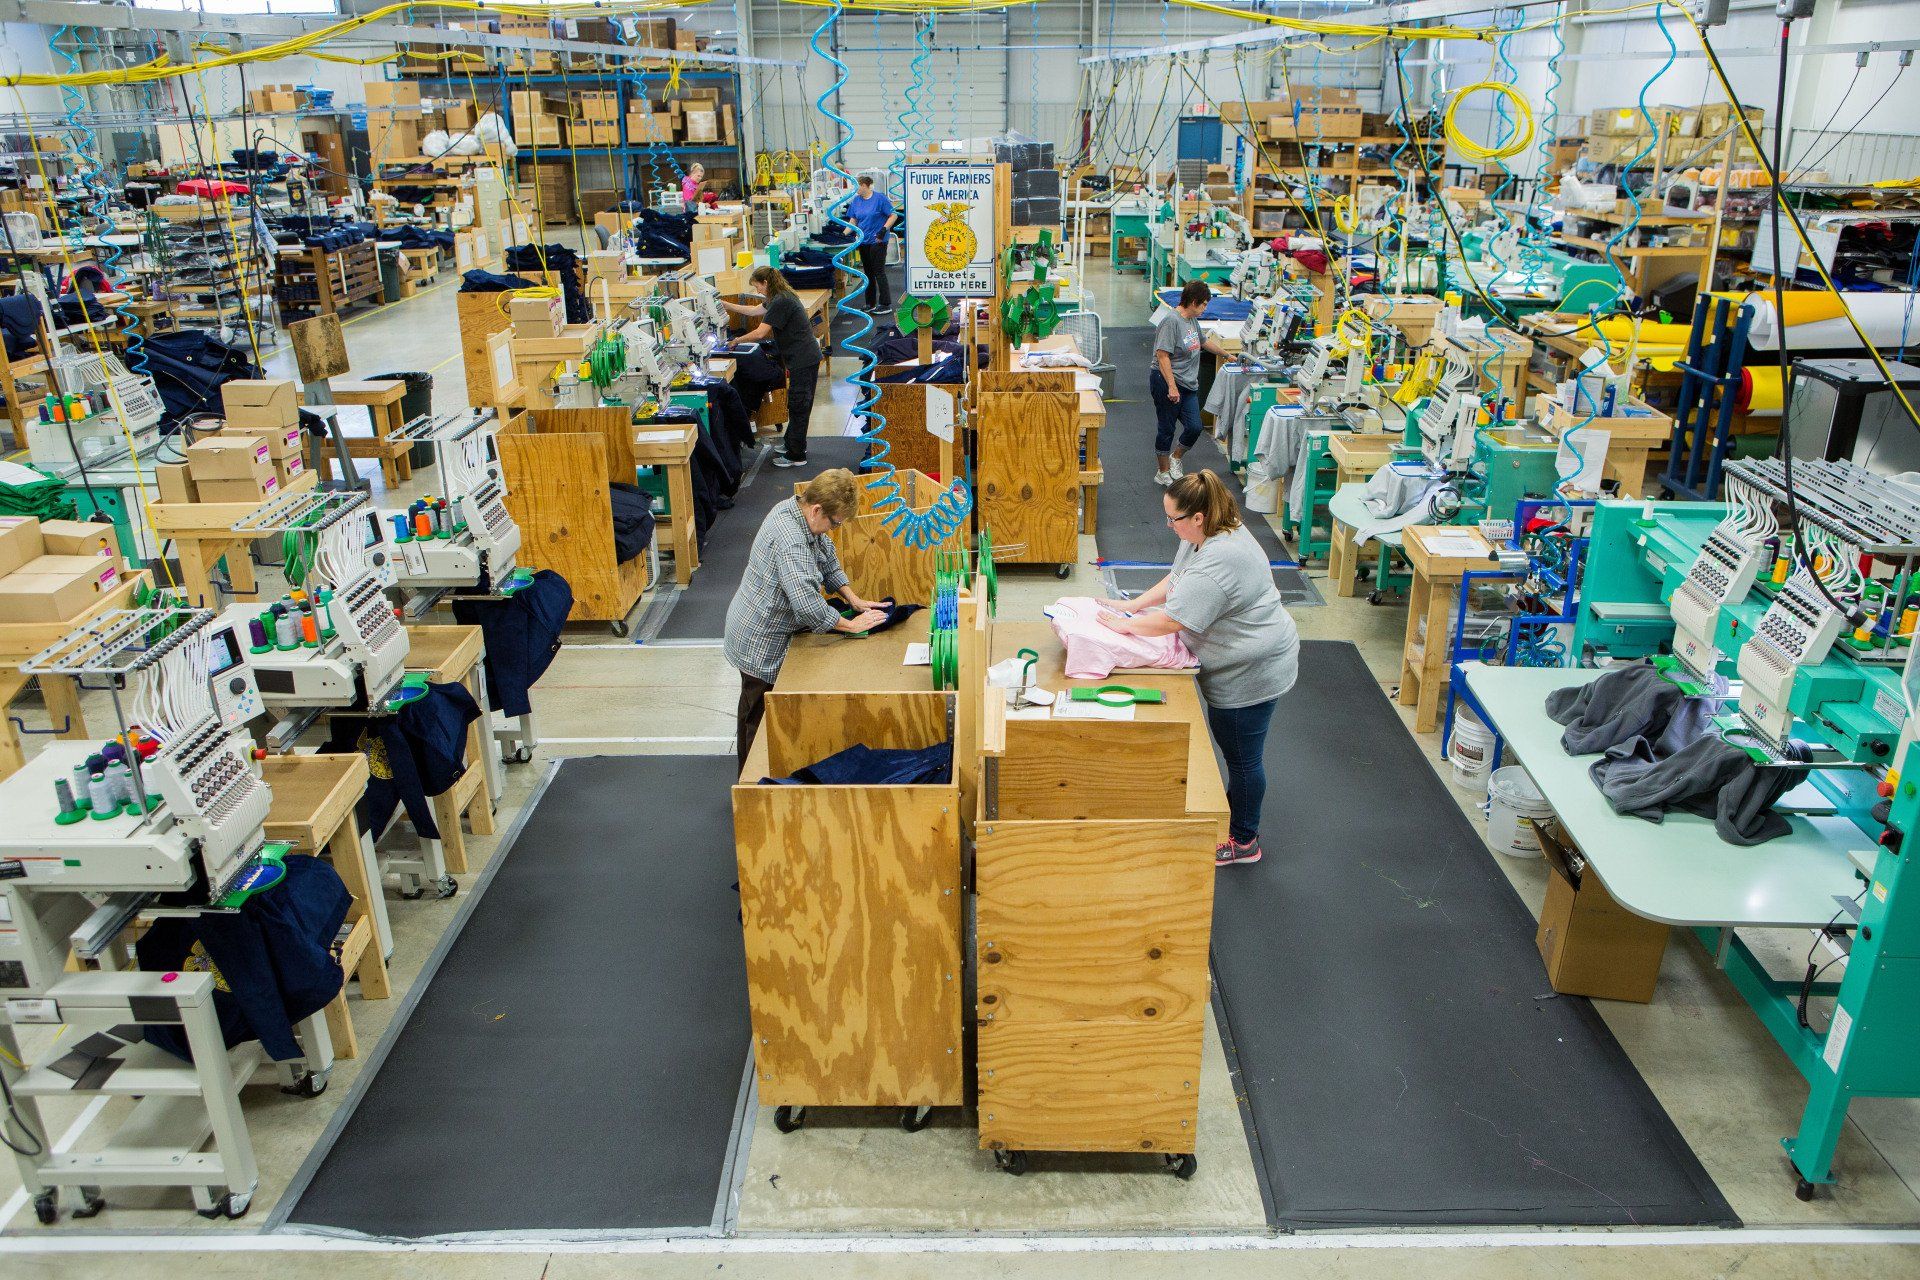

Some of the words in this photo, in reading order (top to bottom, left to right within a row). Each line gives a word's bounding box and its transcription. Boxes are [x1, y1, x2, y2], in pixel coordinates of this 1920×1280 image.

[910, 171, 944, 185] FUTURE
[948, 171, 991, 185] FARMERS
[922, 190, 934, 200] OF
[938, 187, 979, 200] AMERICA
[942, 234, 962, 242] FFA
[926, 269, 976, 279] Jackets
[914, 280, 955, 289] LETTERED
[960, 280, 987, 289] HERE
